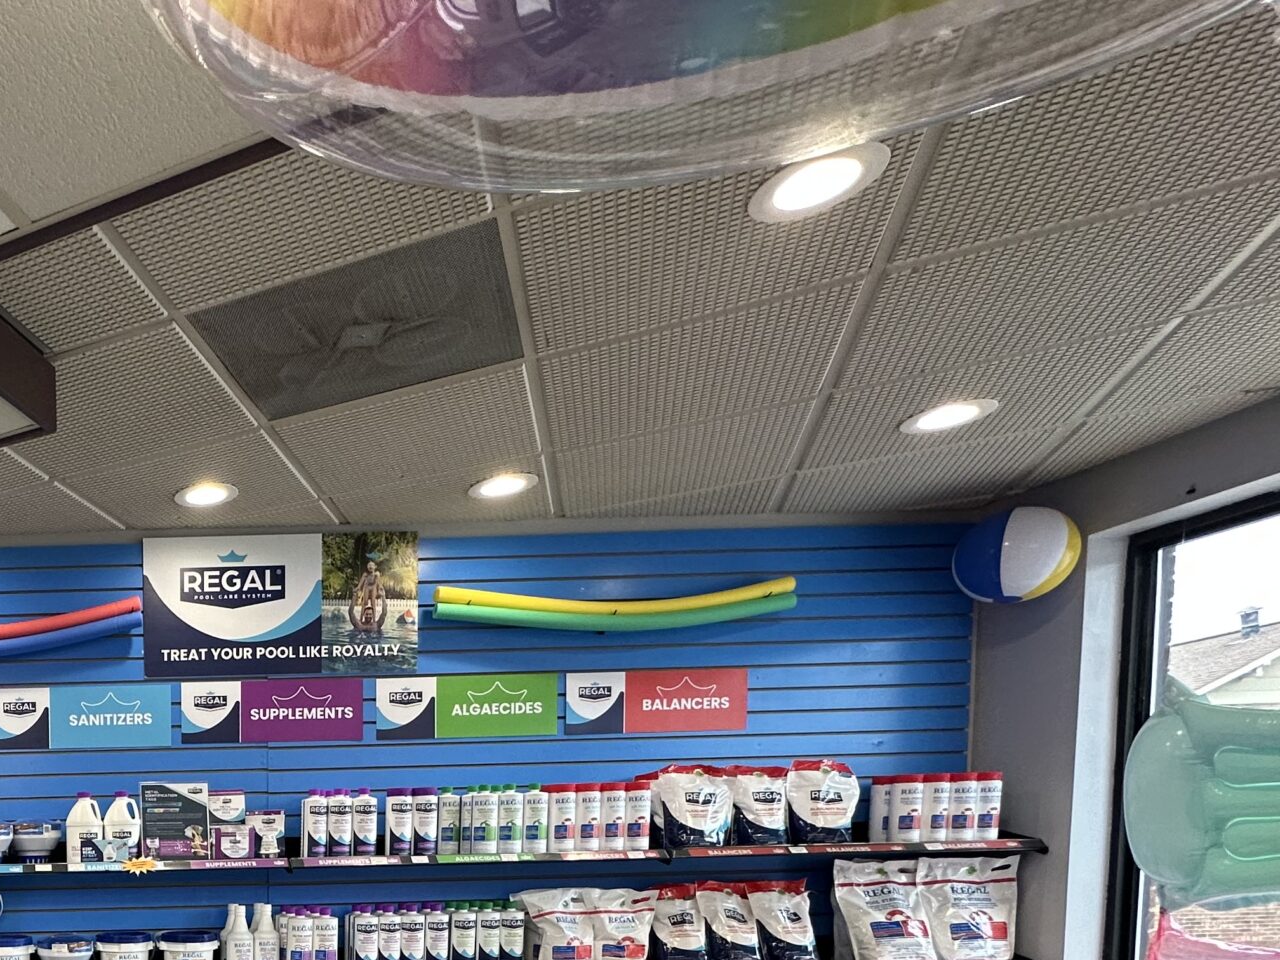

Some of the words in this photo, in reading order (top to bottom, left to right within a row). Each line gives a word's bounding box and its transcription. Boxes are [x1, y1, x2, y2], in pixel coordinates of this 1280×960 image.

[183, 569, 282, 593] REGAL
[161, 648, 208, 662] TREAT
[211, 647, 253, 660] YOUR
[256, 646, 297, 659] POOL
[299, 645, 329, 658] LIKE
[332, 643, 401, 658] ROYALTY
[390, 692, 422, 701] REGAL
[580, 688, 611, 696] REGAL
[4, 703, 36, 712] REGAL
[194, 696, 226, 706] REGAL
[642, 696, 730, 711] BALANCERS
[250, 707, 354, 720] SUPPLEMENTS
[451, 702, 543, 716] ALGAECIDES
[69, 712, 153, 726] SANITIZERS
[864, 886, 904, 898] REGAL
